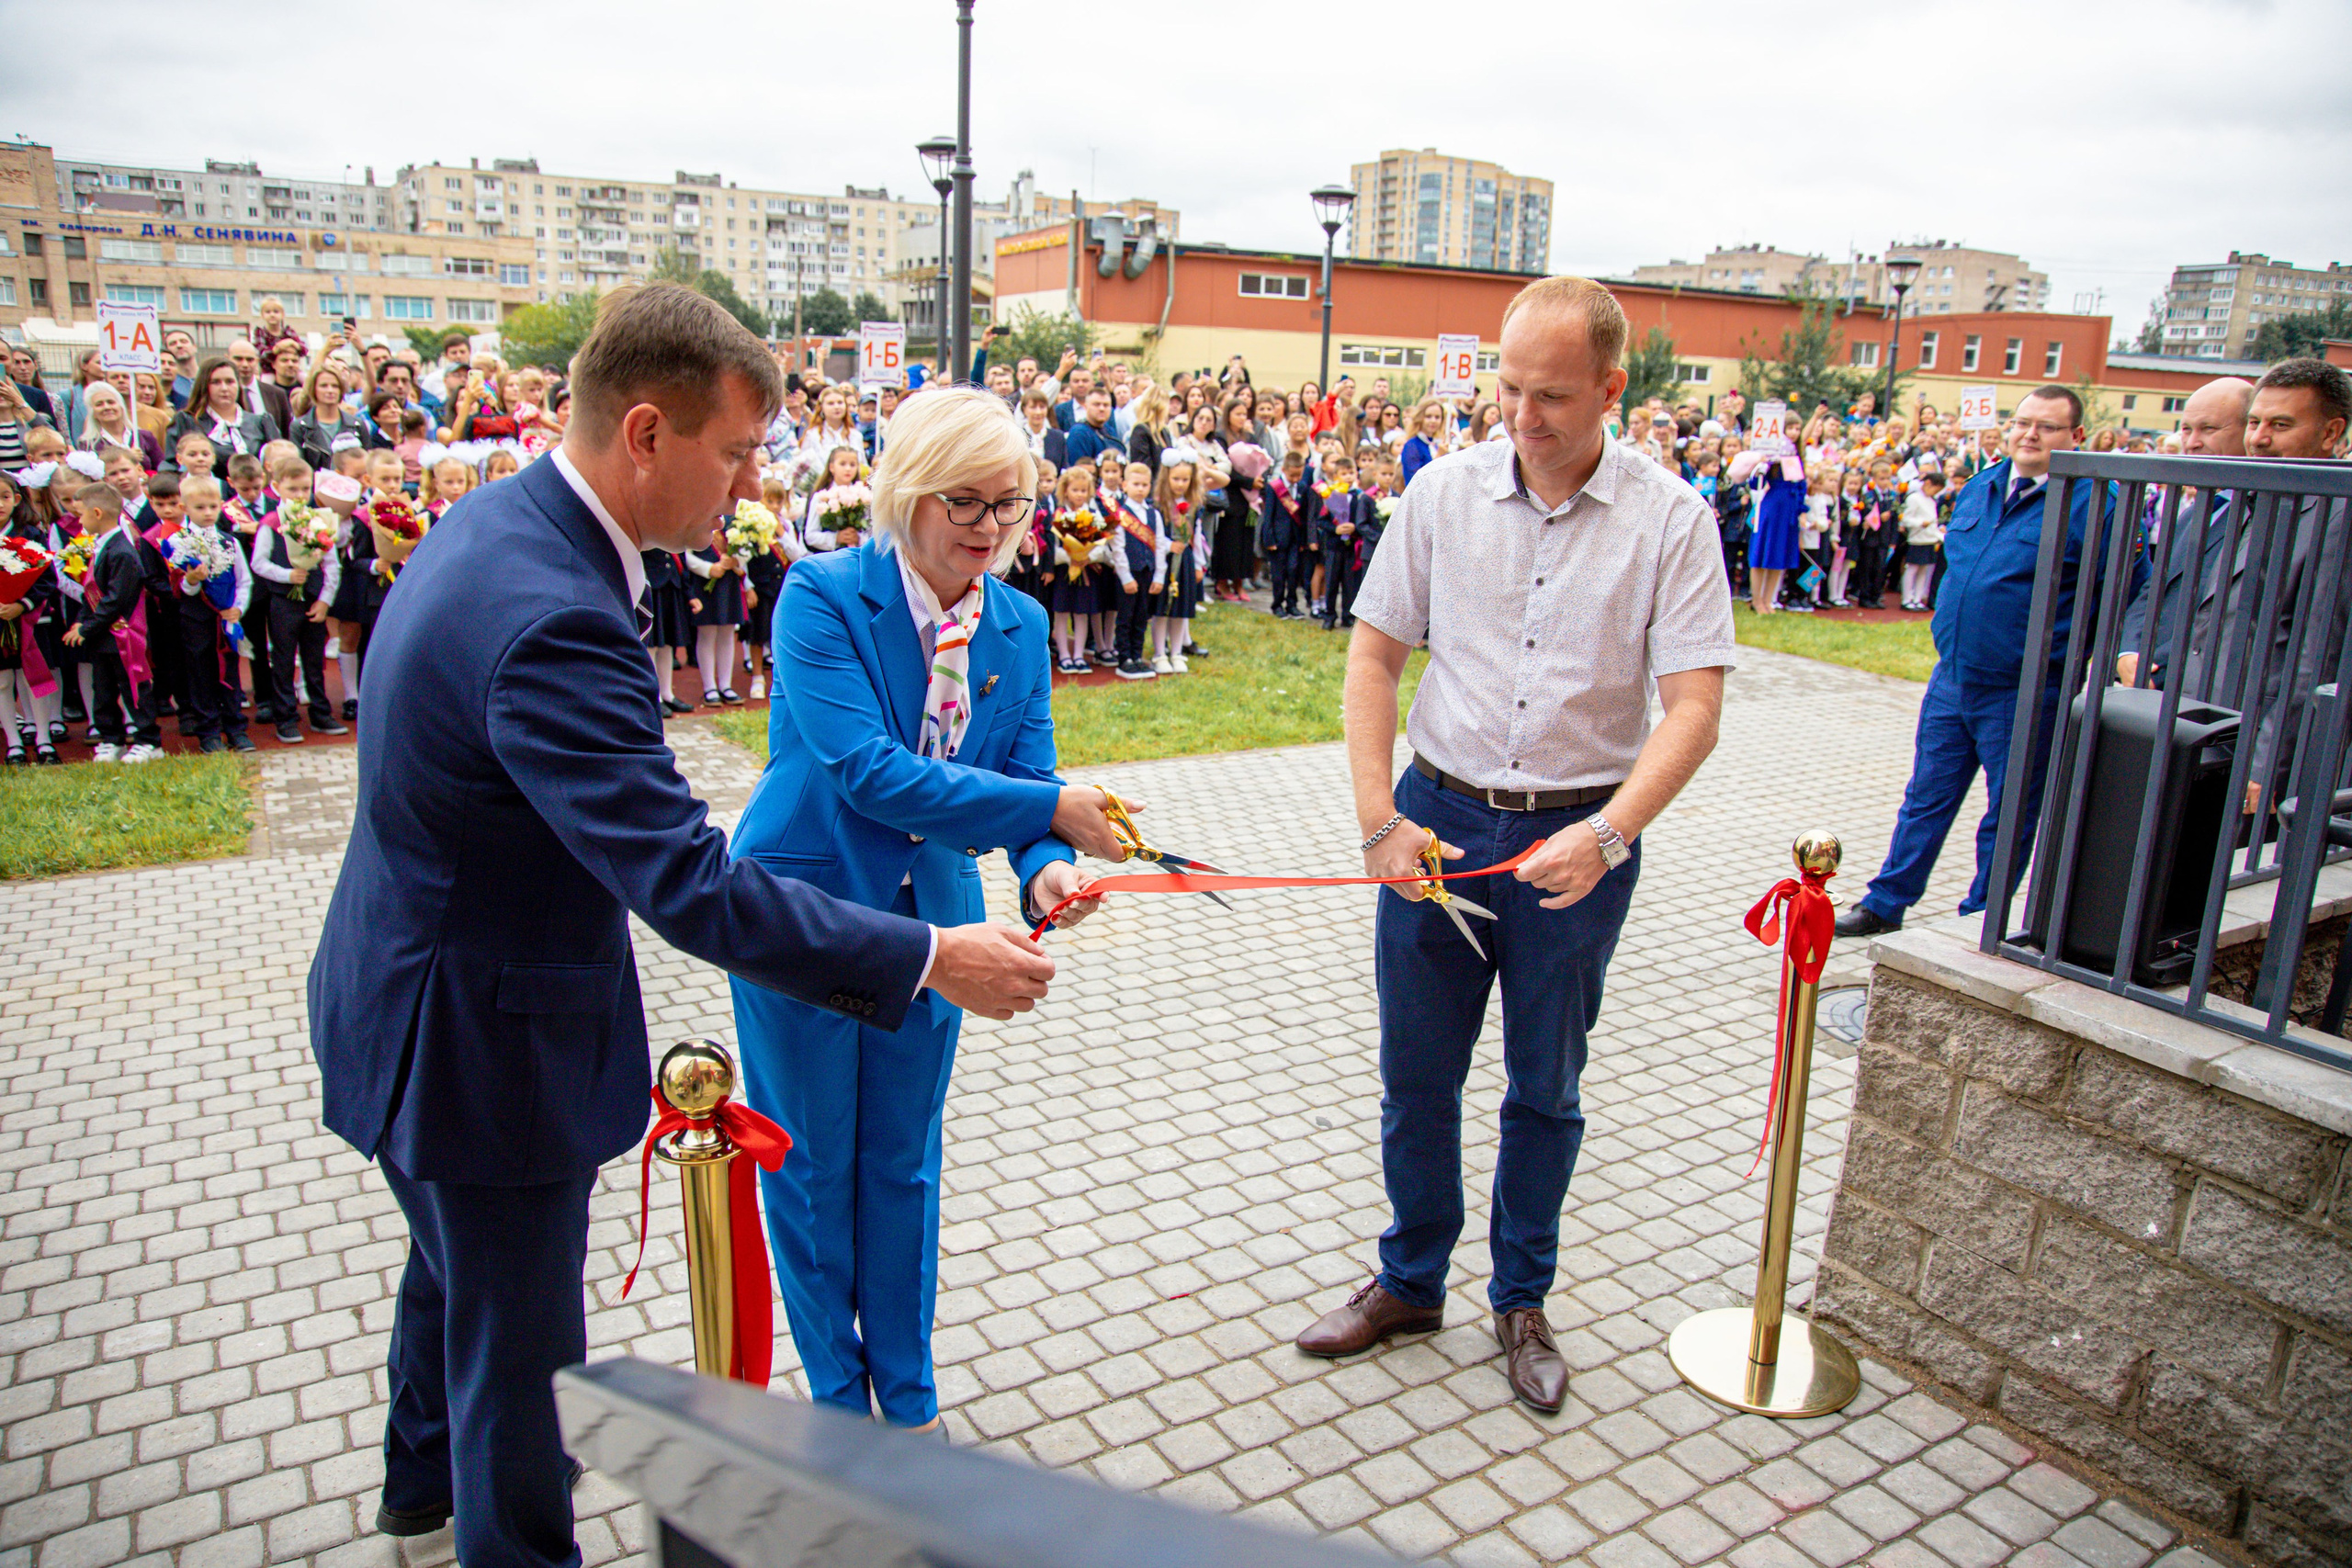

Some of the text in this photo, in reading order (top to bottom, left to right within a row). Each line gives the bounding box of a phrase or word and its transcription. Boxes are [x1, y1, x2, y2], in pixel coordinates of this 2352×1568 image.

[194, 226, 298, 243] СЕНЯВИНА
[103, 321, 154, 352] 1-А
[865, 341, 899, 367] 1-Б
[1441, 352, 1472, 379] 1-В
[1963, 398, 1992, 416] 2-Б
[1754, 417, 1780, 438] 2-А
